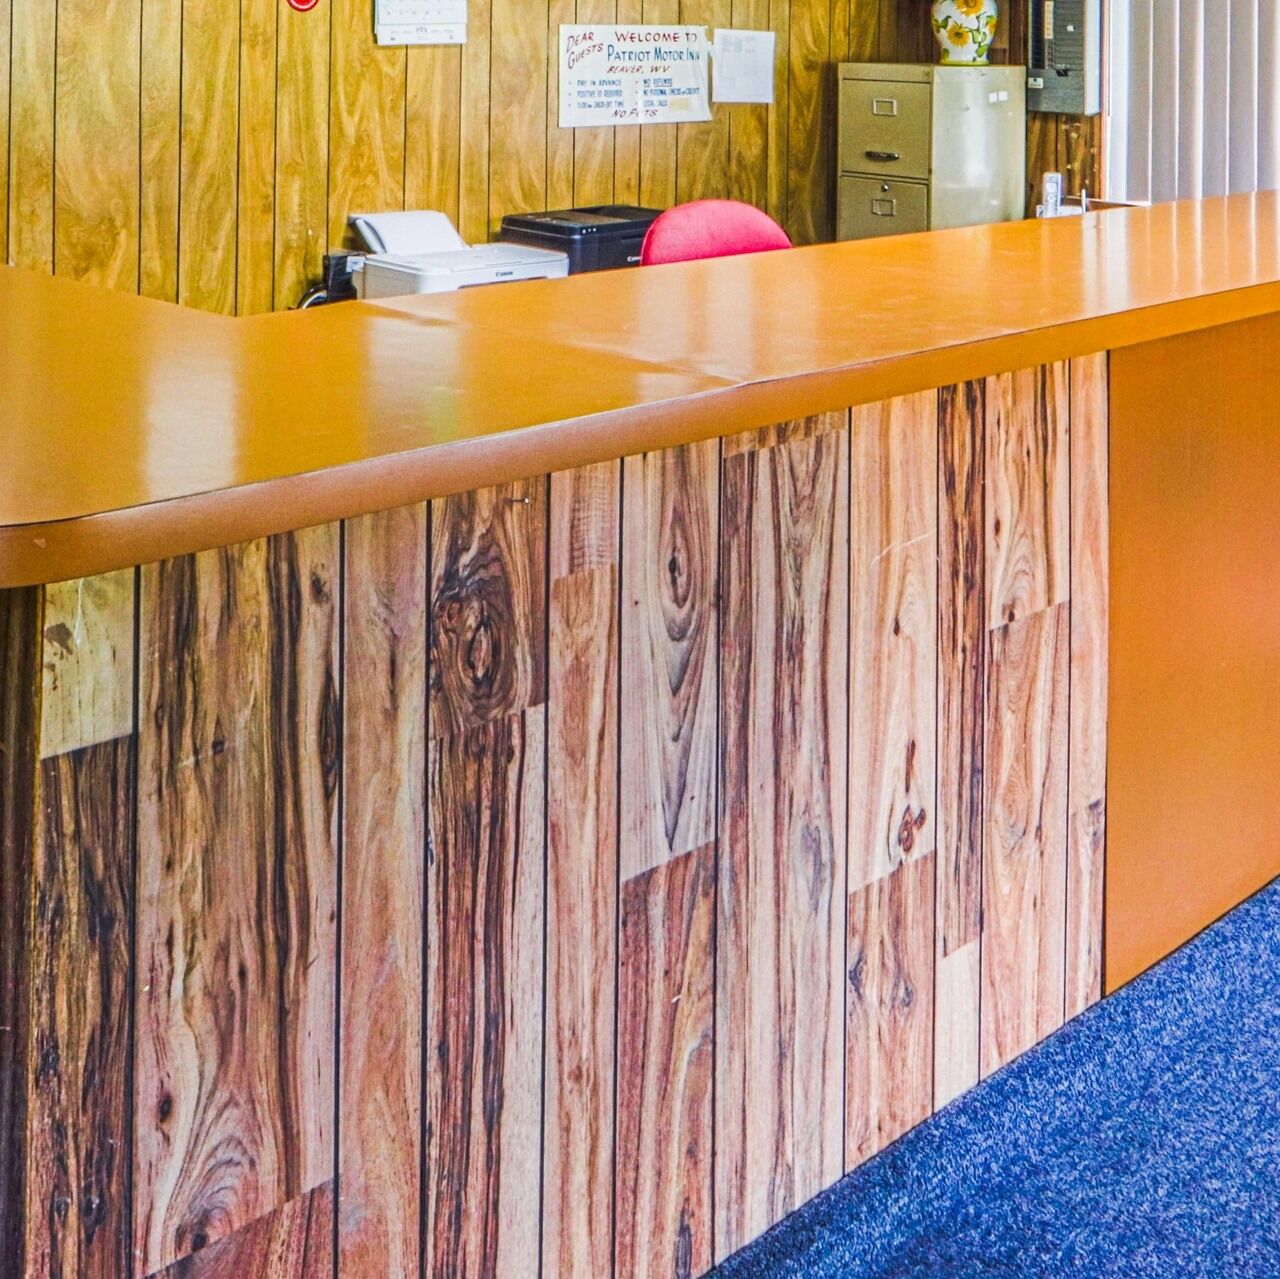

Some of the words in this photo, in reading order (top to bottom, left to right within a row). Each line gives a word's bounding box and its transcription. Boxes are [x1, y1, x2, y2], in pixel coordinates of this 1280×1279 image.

[566, 32, 595, 53] DEAR
[615, 31, 680, 43] WELCOME
[685, 32, 698, 43] TO
[567, 42, 604, 69] GUESTS
[607, 44, 651, 62] PATRIOT
[654, 46, 684, 62] MOTOR
[611, 109, 626, 118] NO
